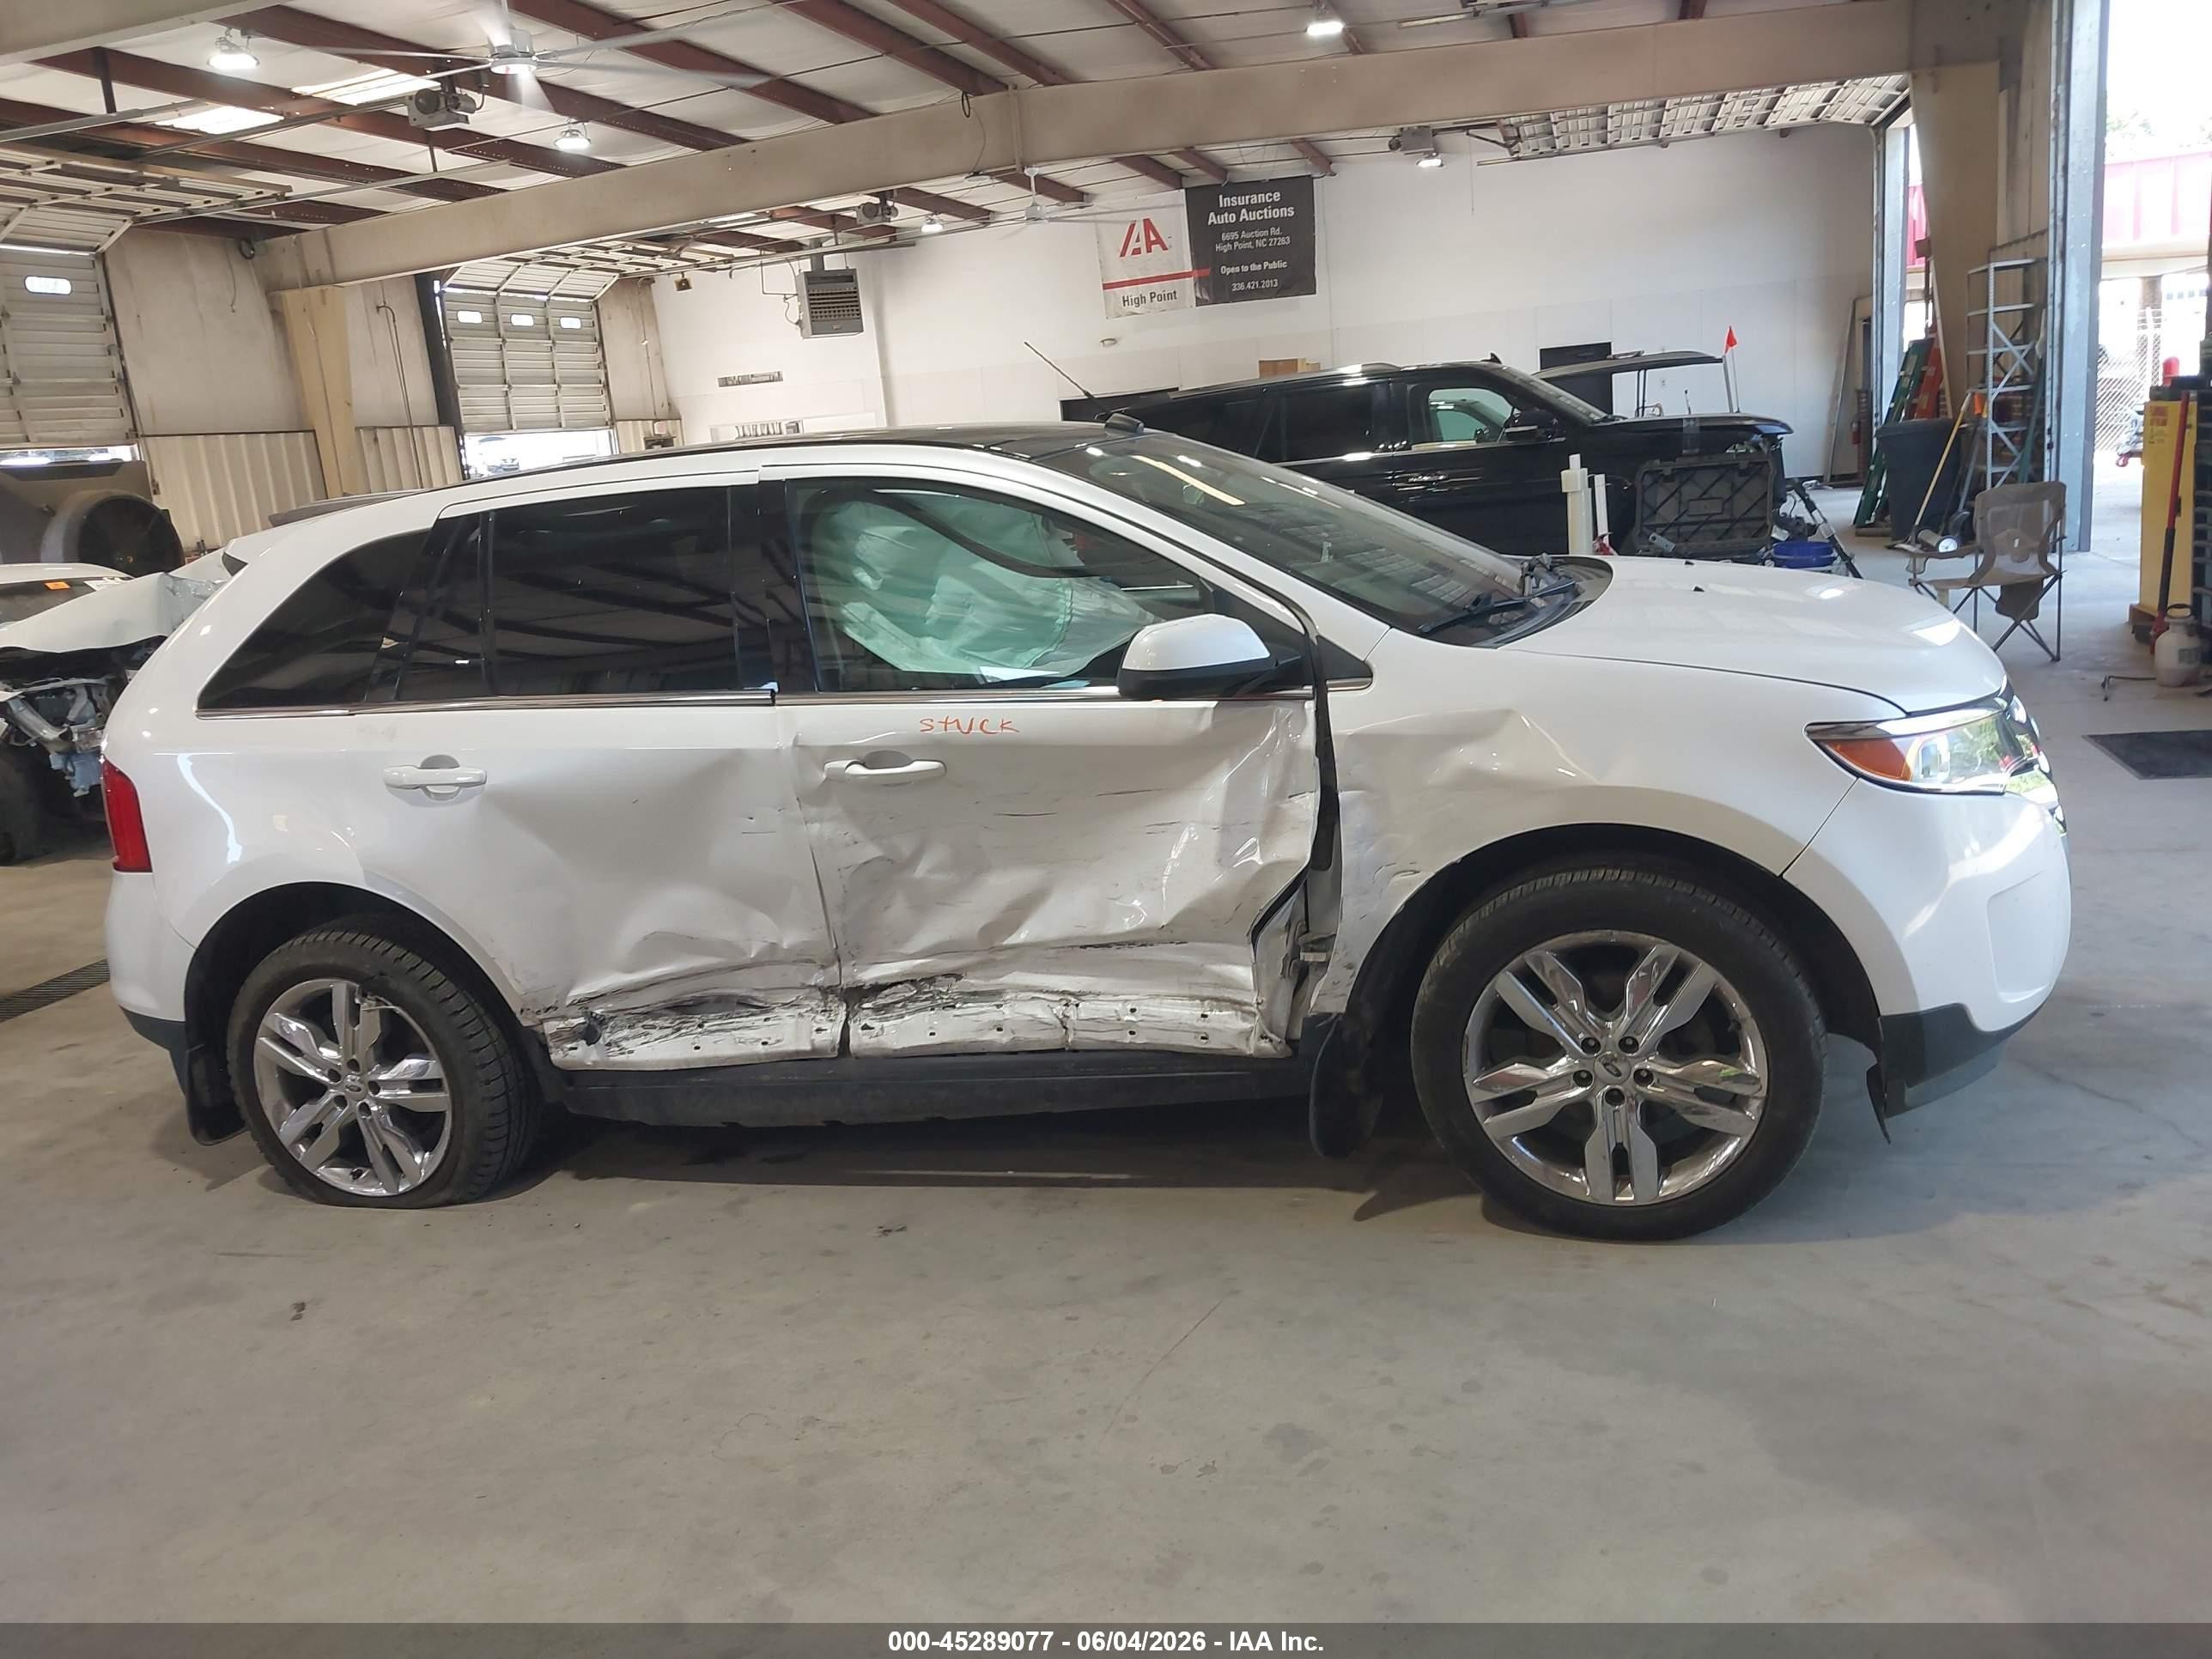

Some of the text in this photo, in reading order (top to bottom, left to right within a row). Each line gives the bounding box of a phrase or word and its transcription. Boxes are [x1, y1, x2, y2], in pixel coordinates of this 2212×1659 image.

[1218, 191, 1281, 208] Insurance
[1207, 206, 1295, 225] Auto Auctions
[1241, 228, 1268, 239] Auction
[1270, 227, 1283, 236] Rd.
[1215, 242, 1232, 252] High
[1234, 240, 1255, 250] Point,
[1256, 239, 1267, 248] NC
[1220, 260, 1288, 275] Open to the Public
[1122, 289, 1177, 308] High Point
